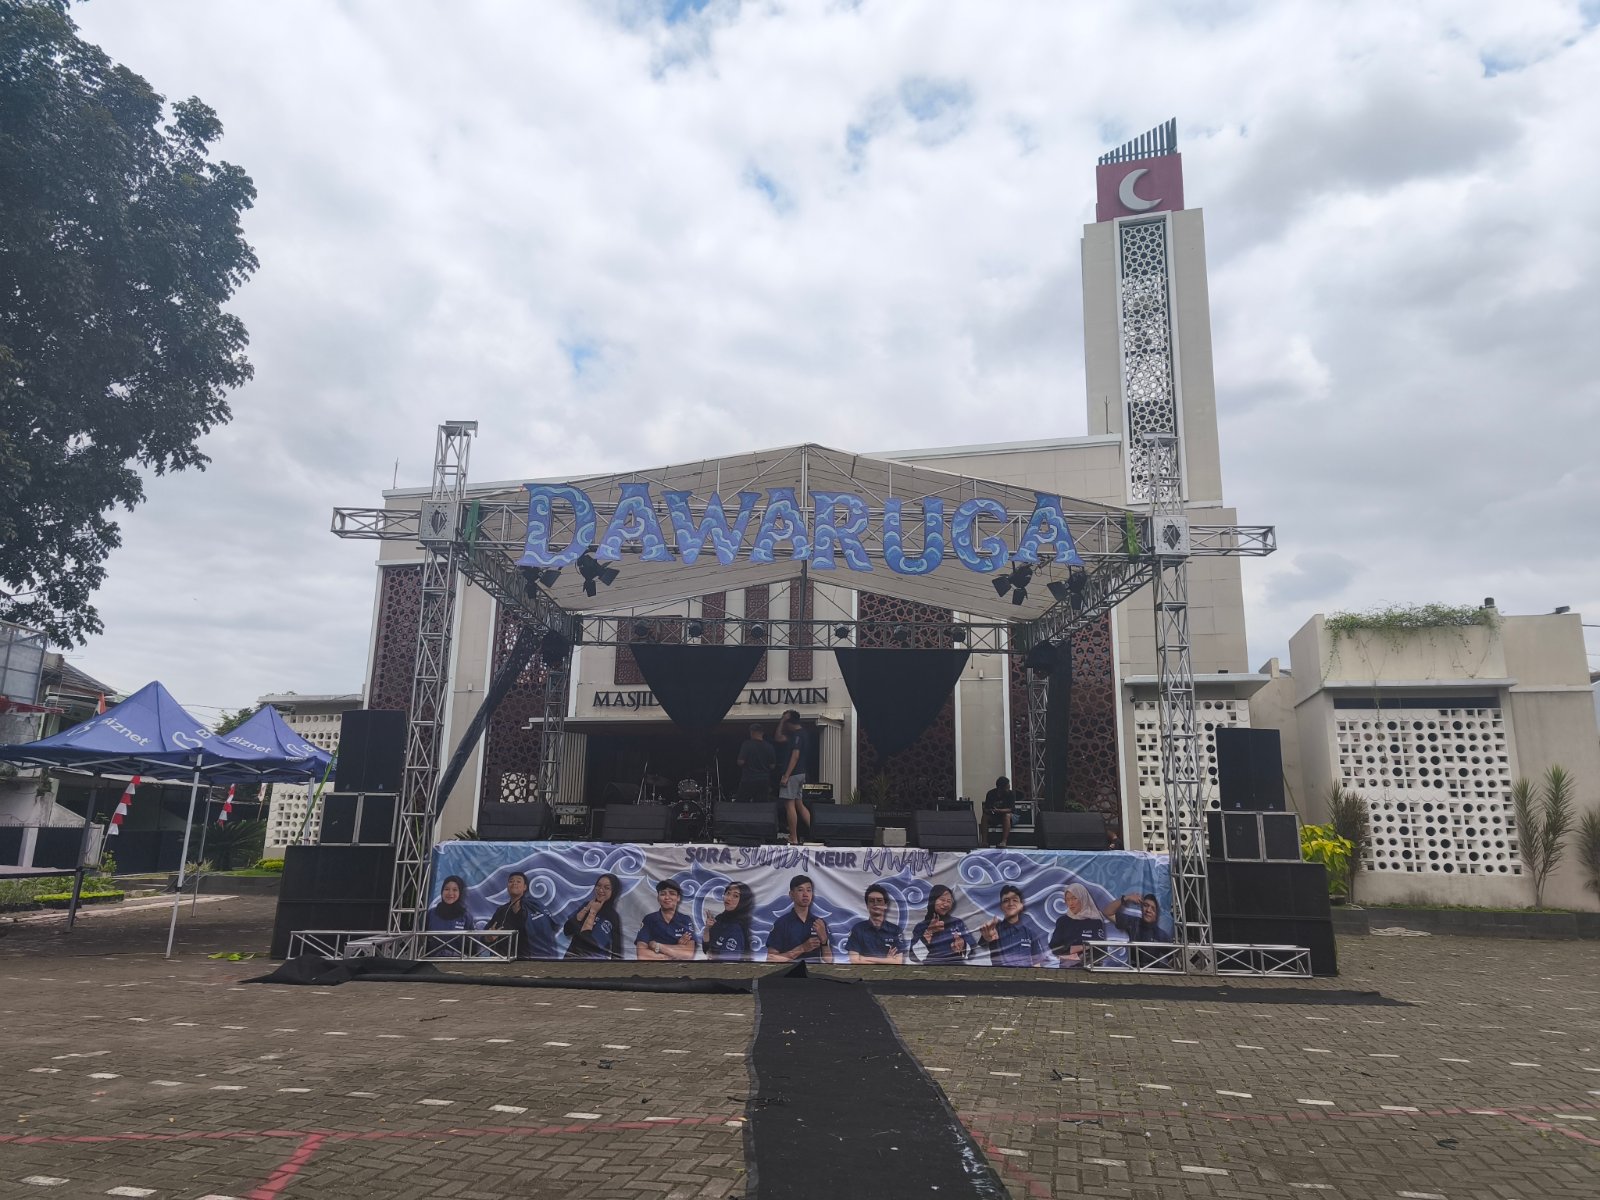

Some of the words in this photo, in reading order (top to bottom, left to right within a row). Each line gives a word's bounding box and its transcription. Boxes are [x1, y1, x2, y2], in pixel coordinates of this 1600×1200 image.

[515, 482, 1085, 575] DAWARUGA
[226, 736, 272, 754] Biznet
[684, 846, 732, 865] SORA
[736, 846, 809, 872] SUNDA
[814, 850, 858, 868] KEUR
[862, 847, 938, 878] KIWARI
